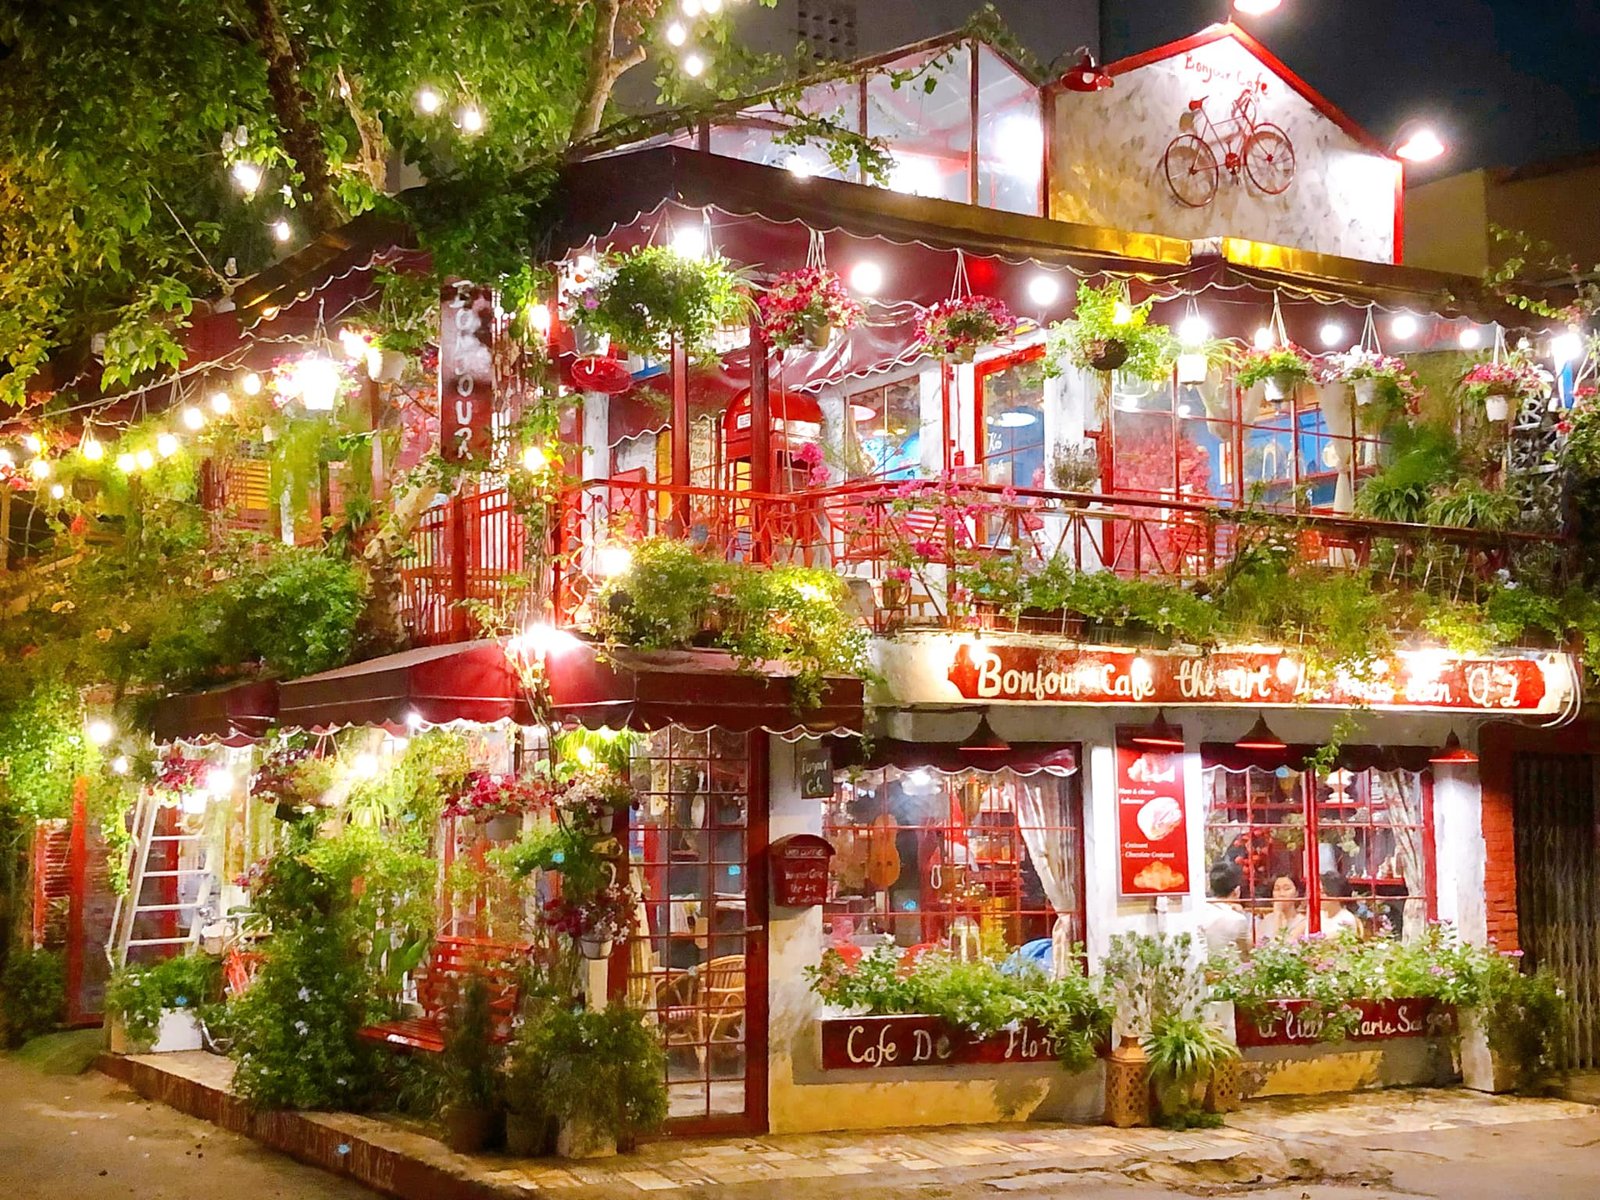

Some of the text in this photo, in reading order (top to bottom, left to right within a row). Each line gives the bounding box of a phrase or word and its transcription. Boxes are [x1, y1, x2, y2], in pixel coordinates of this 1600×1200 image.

[975, 652, 1088, 700] Bonjour
[1174, 660, 1216, 698] the
[847, 1024, 898, 1067] Cafe
[912, 1029, 951, 1062] De
